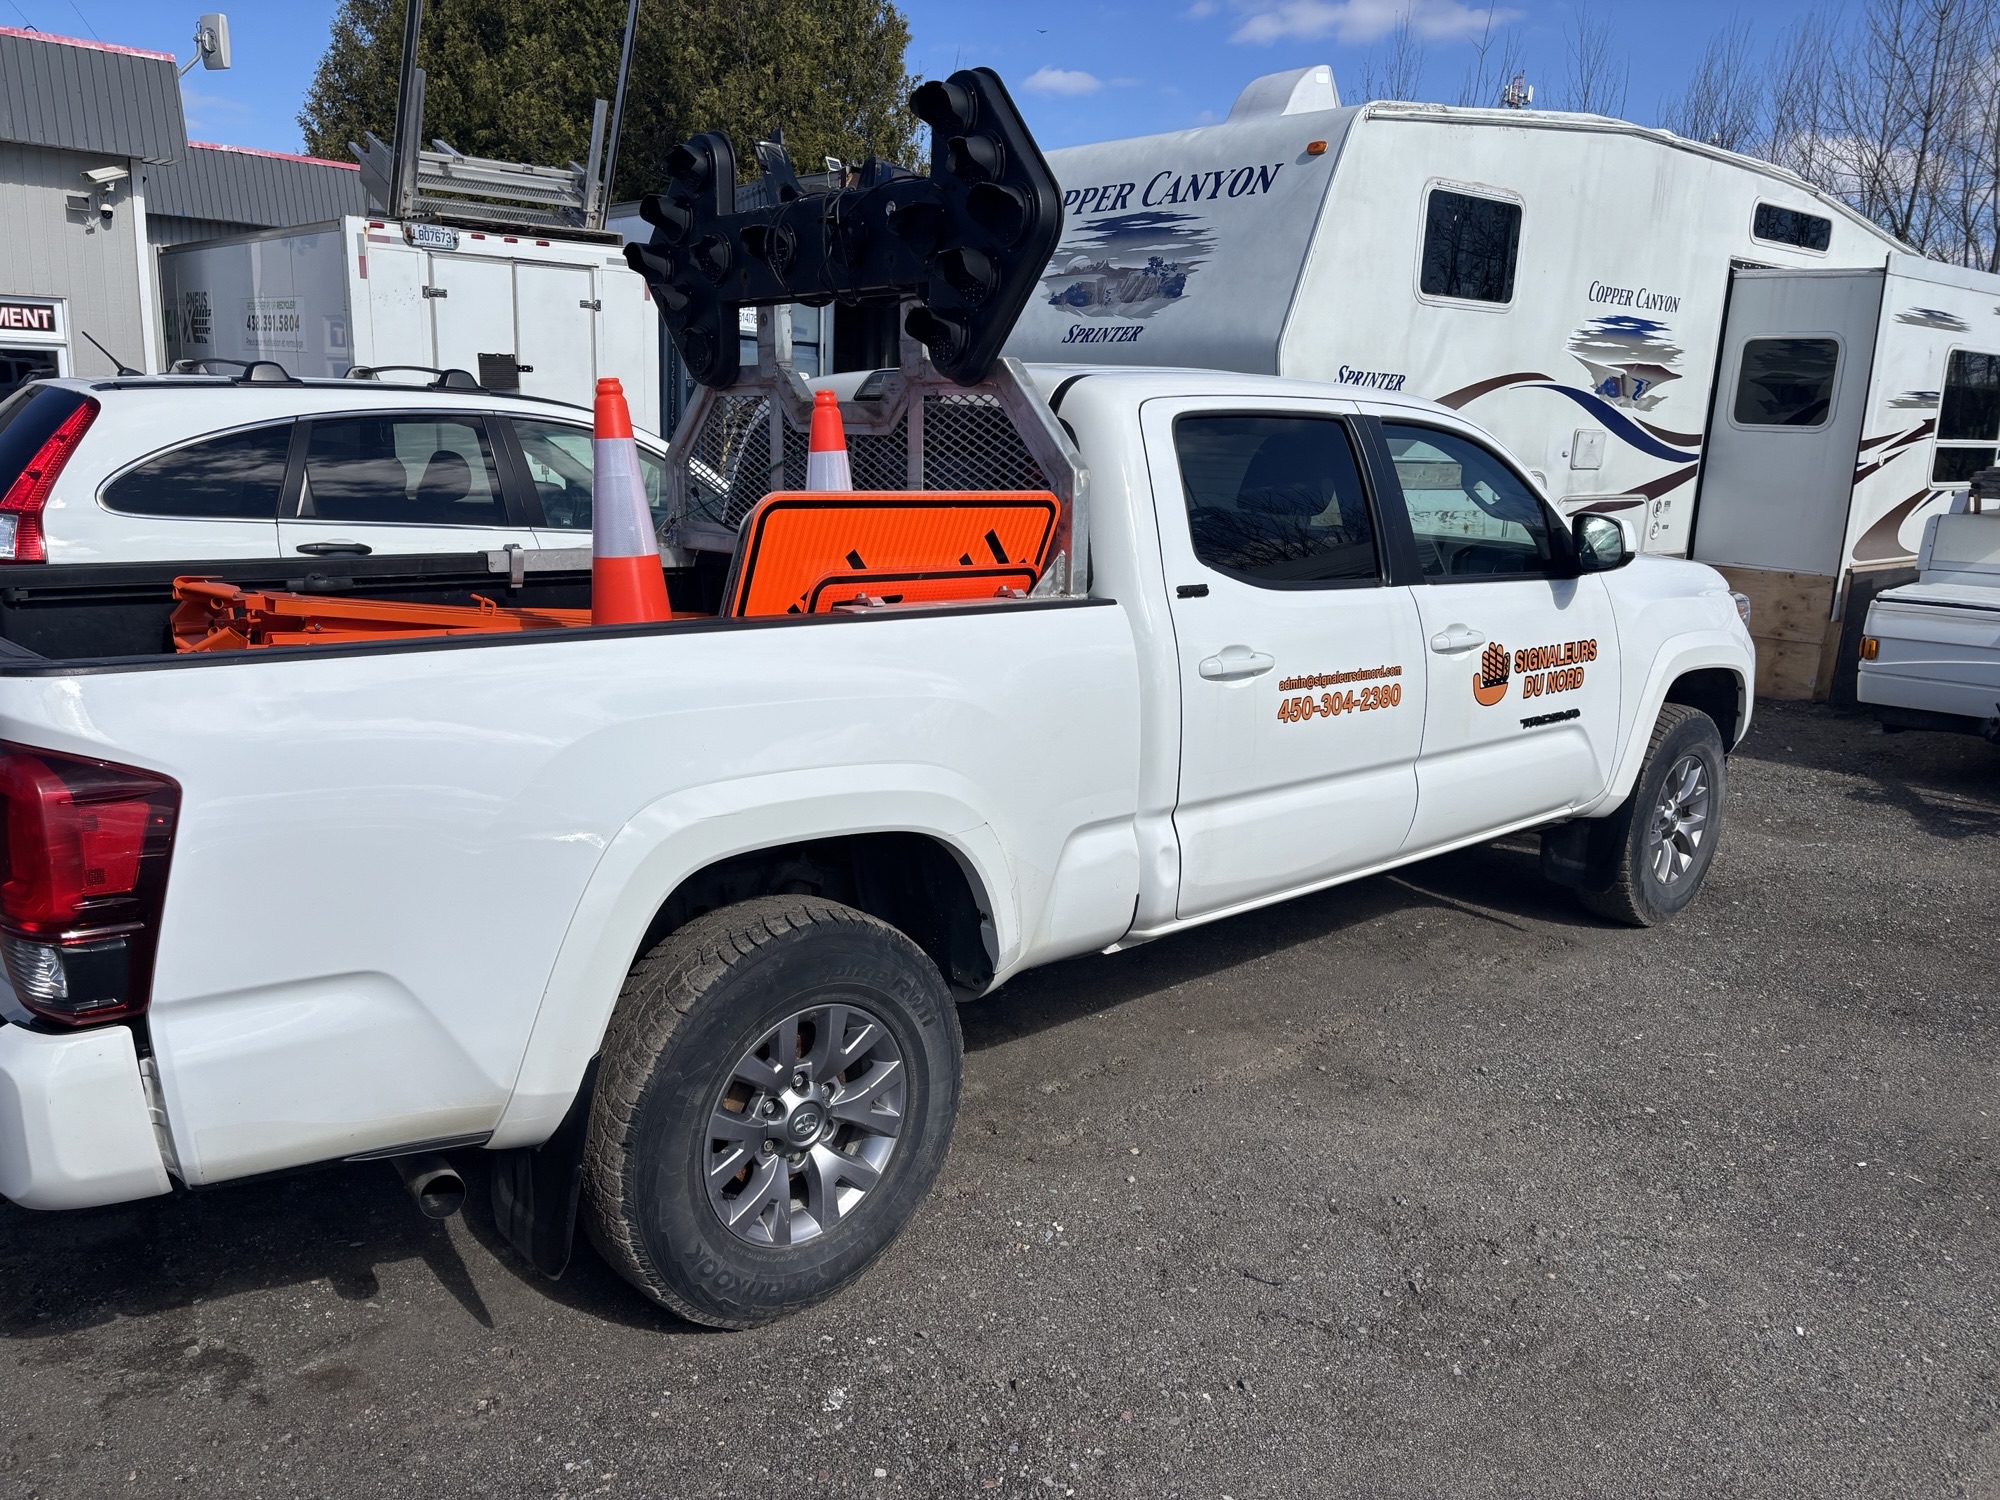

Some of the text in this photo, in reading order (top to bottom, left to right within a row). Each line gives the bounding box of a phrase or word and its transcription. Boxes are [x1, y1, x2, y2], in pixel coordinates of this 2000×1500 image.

[1141, 163, 1284, 207] CANYON
[185, 291, 208, 309] PNEUS
[1588, 280, 1681, 313] COPPER CANYON
[246, 314, 300, 332] 438.391.5804
[1061, 324, 1144, 344] SPRINTER
[1334, 365, 1406, 391] SPRINTER
[1514, 638, 1597, 674] SIGNALEURS
[1279, 665, 1402, 691] admin@signaleursdunord.com
[1523, 666, 1584, 699] DU NORD
[1277, 683, 1402, 723] 450-304-2380
